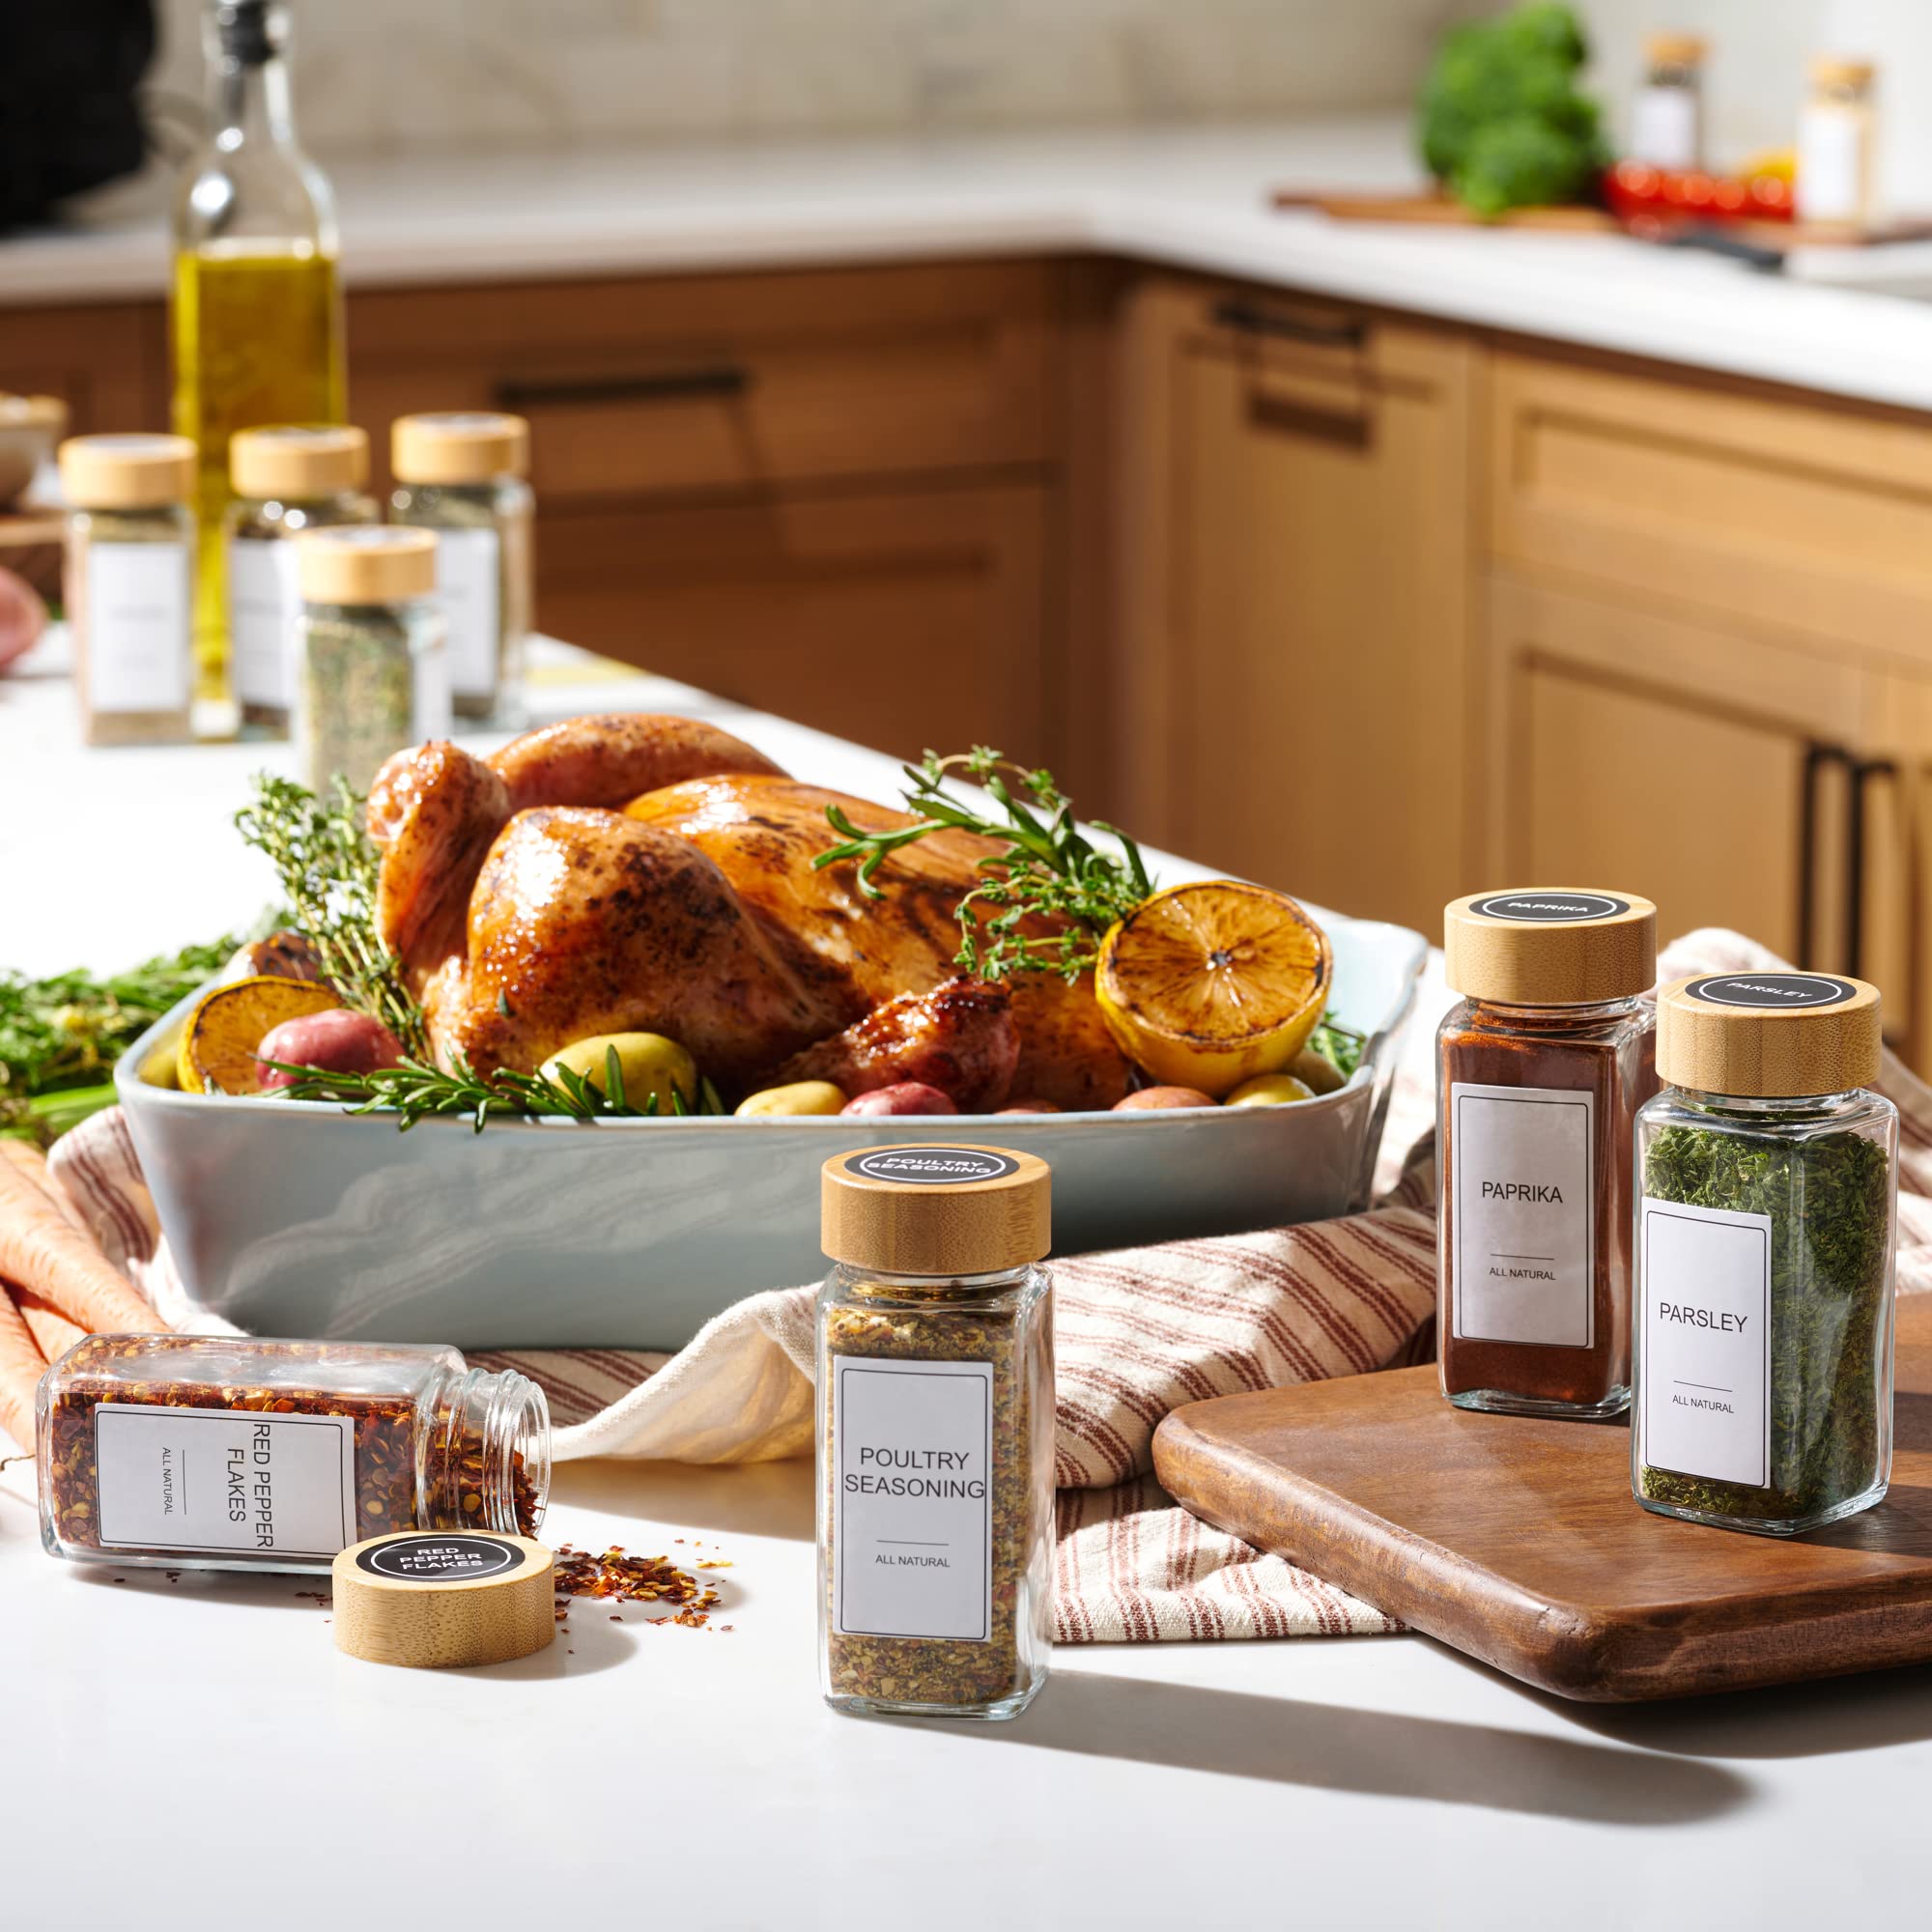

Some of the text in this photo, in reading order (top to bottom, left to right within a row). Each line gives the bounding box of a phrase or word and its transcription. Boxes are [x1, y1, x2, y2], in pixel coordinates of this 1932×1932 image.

[1507, 901, 1588, 912] PAPRIKA
[1726, 982, 1813, 998] PARSLEY
[867, 1162, 992, 1174] SEASONING
[886, 1157, 984, 1167] POULTRY
[1482, 1181, 1563, 1204] PAPRIKA
[1489, 1266, 1556, 1281] ALL NATURAL
[1660, 1301, 1747, 1333] PARSLEY
[1672, 1394, 1734, 1414] ALL NATURAL
[860, 1447, 970, 1470] POULTRY
[162, 1447, 173, 1516] ALL NATURAL
[227, 1448, 246, 1522] FLAKES
[253, 1423, 273, 1548] RED PEPPER
[844, 1473, 984, 1498] SEASONING
[399, 1553, 482, 1563] PEPPER
[402, 1560, 483, 1570] FLAKES
[875, 1554, 951, 1568] ALL NATURAL
